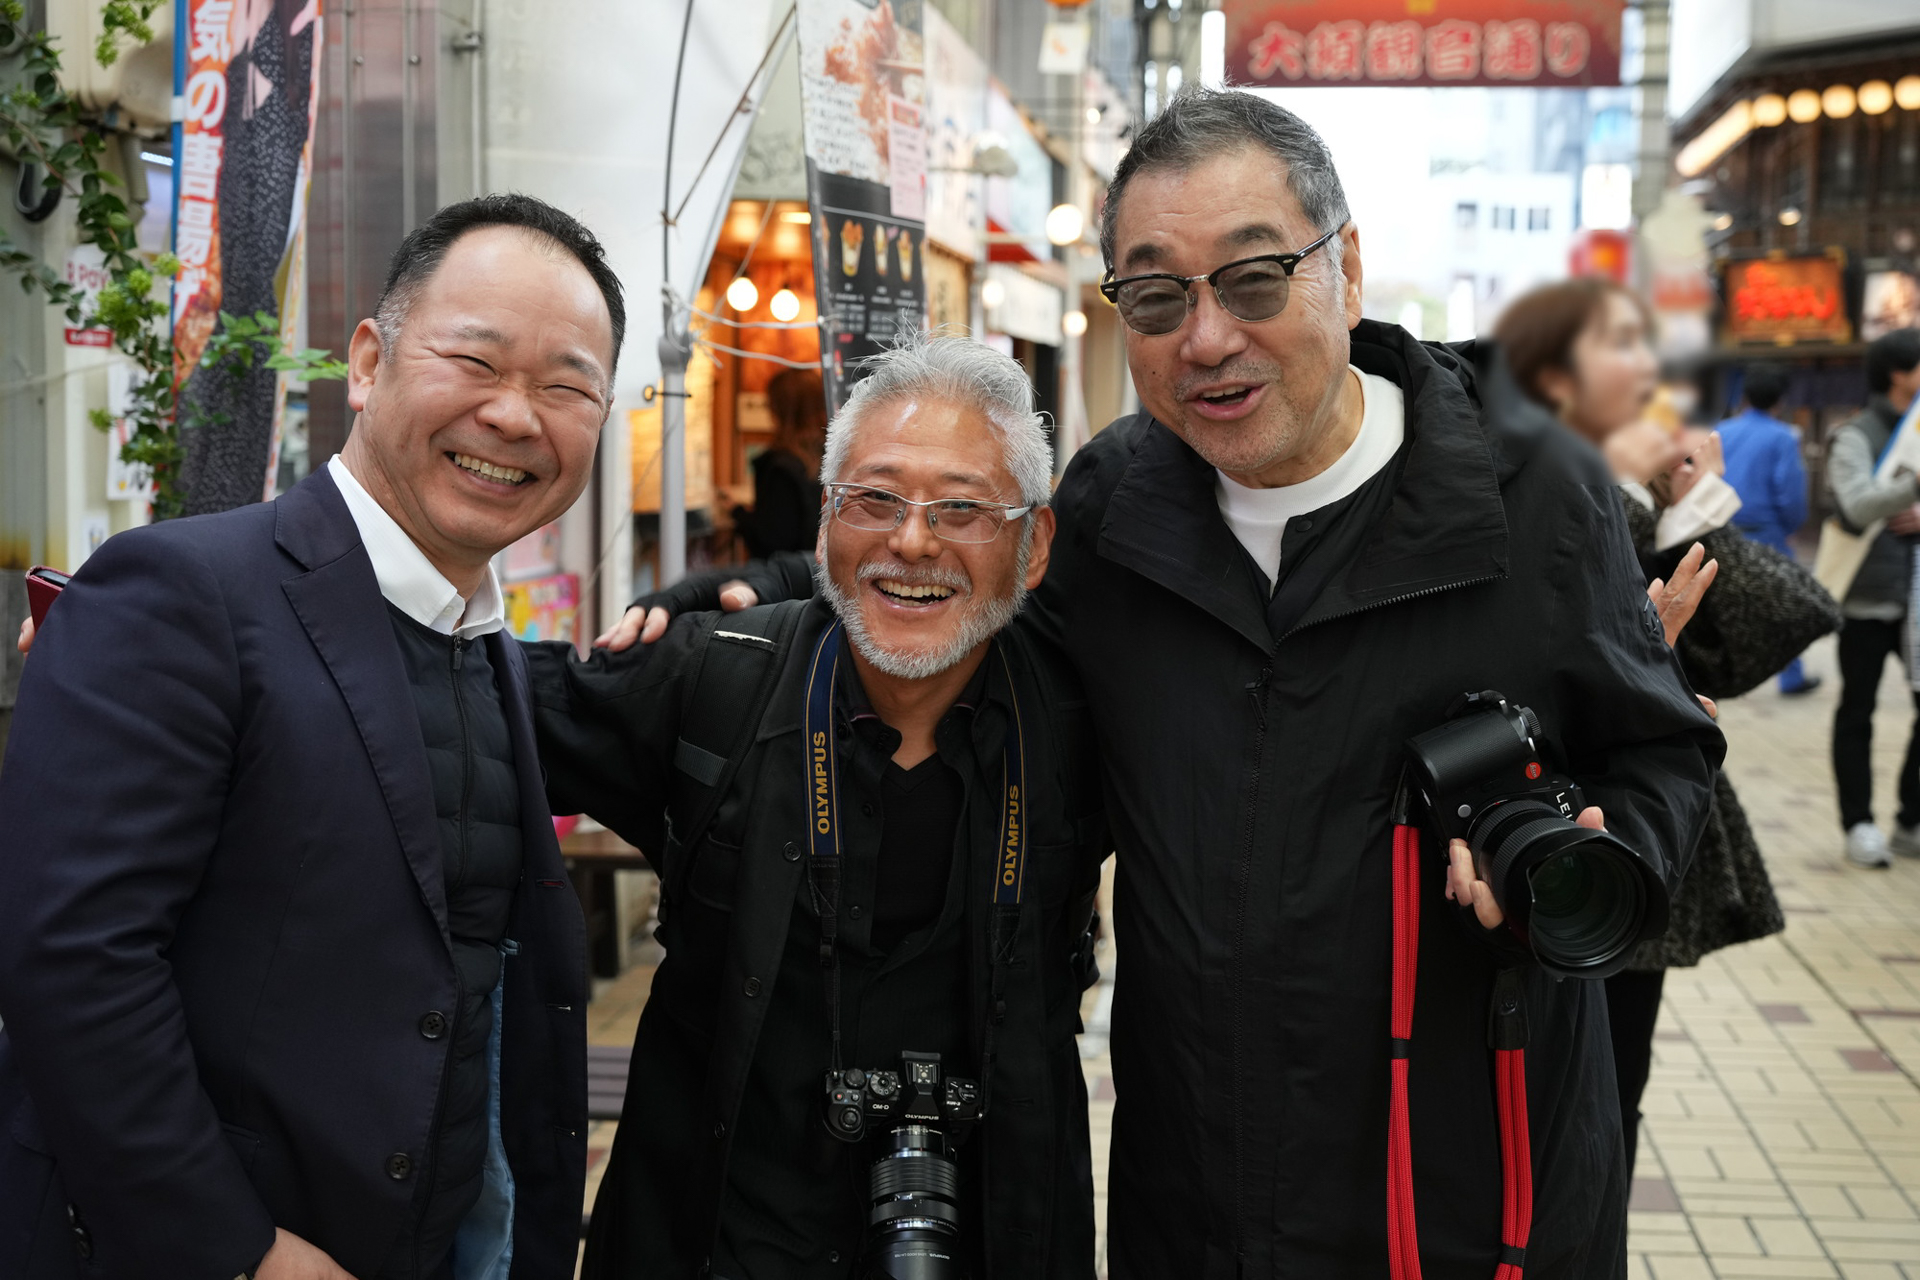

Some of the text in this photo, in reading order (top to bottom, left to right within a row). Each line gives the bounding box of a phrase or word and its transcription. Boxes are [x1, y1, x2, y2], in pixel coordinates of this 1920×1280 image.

[813, 731, 830, 835] OLYMPUS
[1556, 792, 1574, 822] LEI
[1003, 785, 1019, 886] OLYMPUS
[905, 1113, 940, 1121] OLYMPUS
